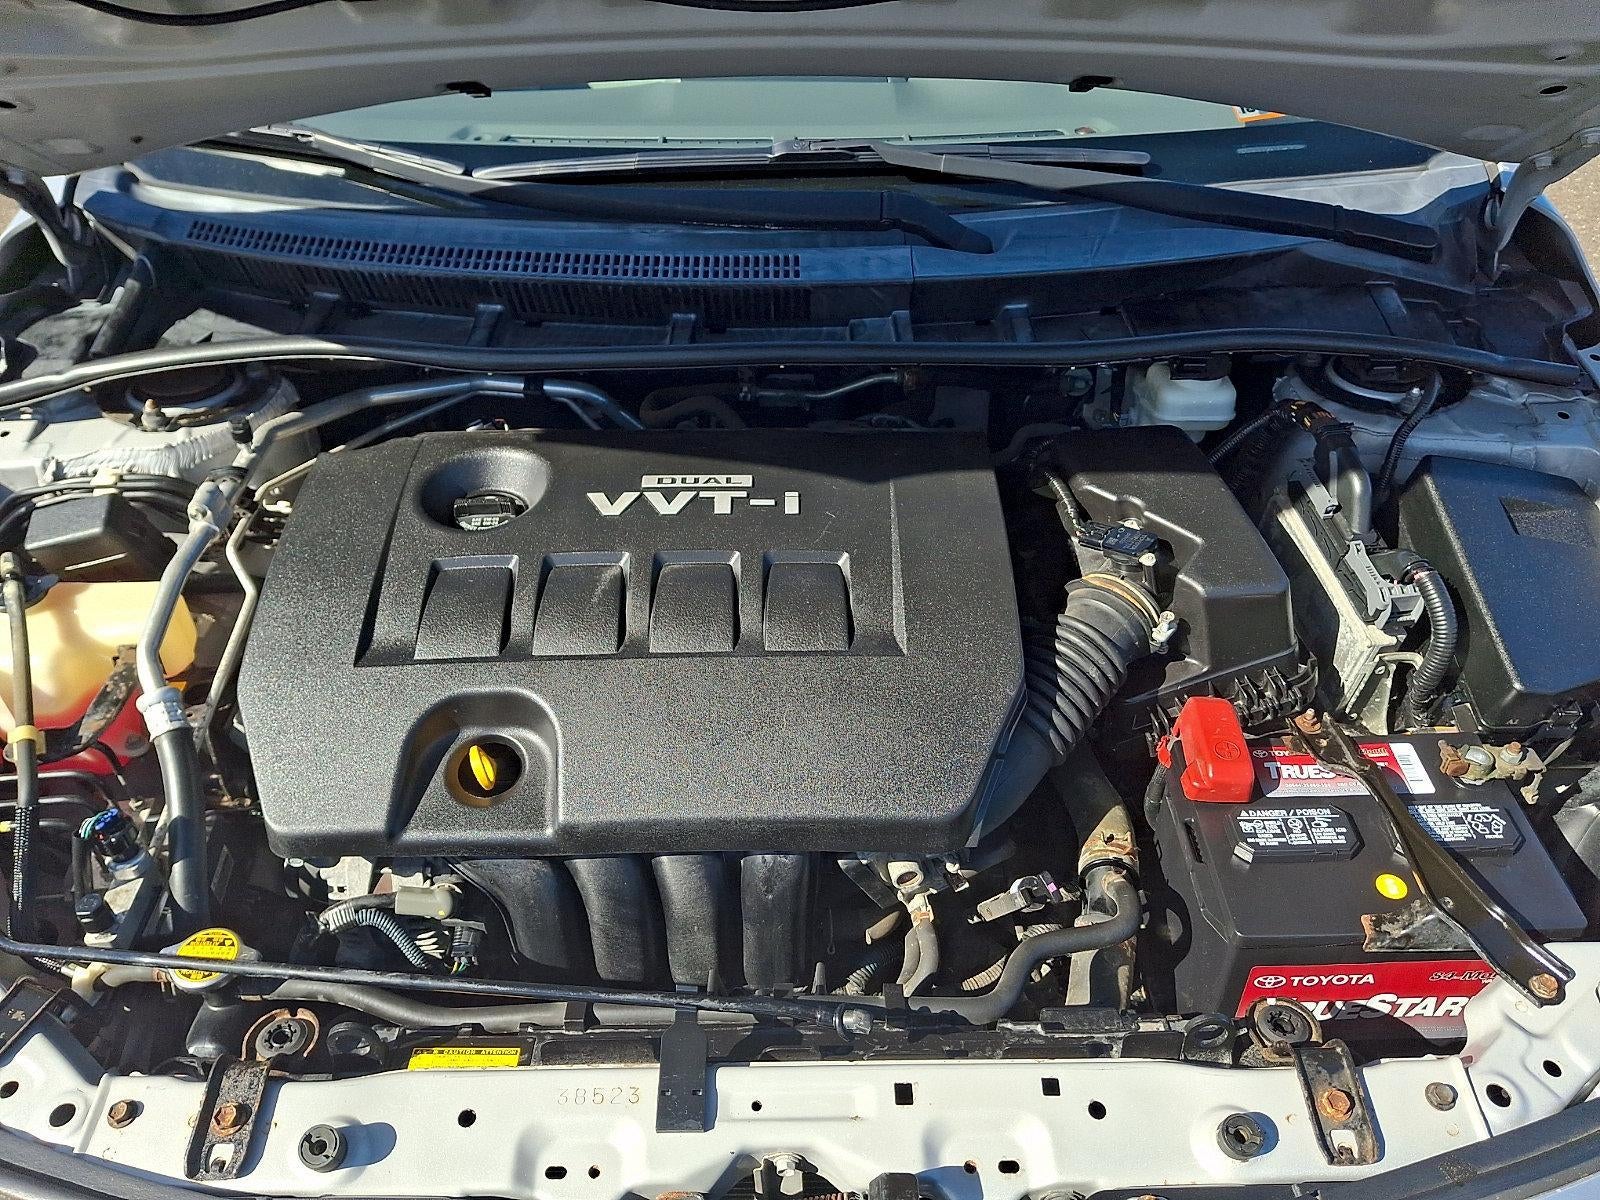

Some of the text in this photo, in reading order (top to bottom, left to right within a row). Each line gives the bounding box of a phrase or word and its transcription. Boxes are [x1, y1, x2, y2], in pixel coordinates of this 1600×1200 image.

[657, 476, 743, 486] DUAL
[1248, 809, 1287, 817] DANGER
[1296, 807, 1332, 816] POISON
[1290, 973, 1375, 987] TOYOTA
[557, 1086, 641, 1106] 38523
